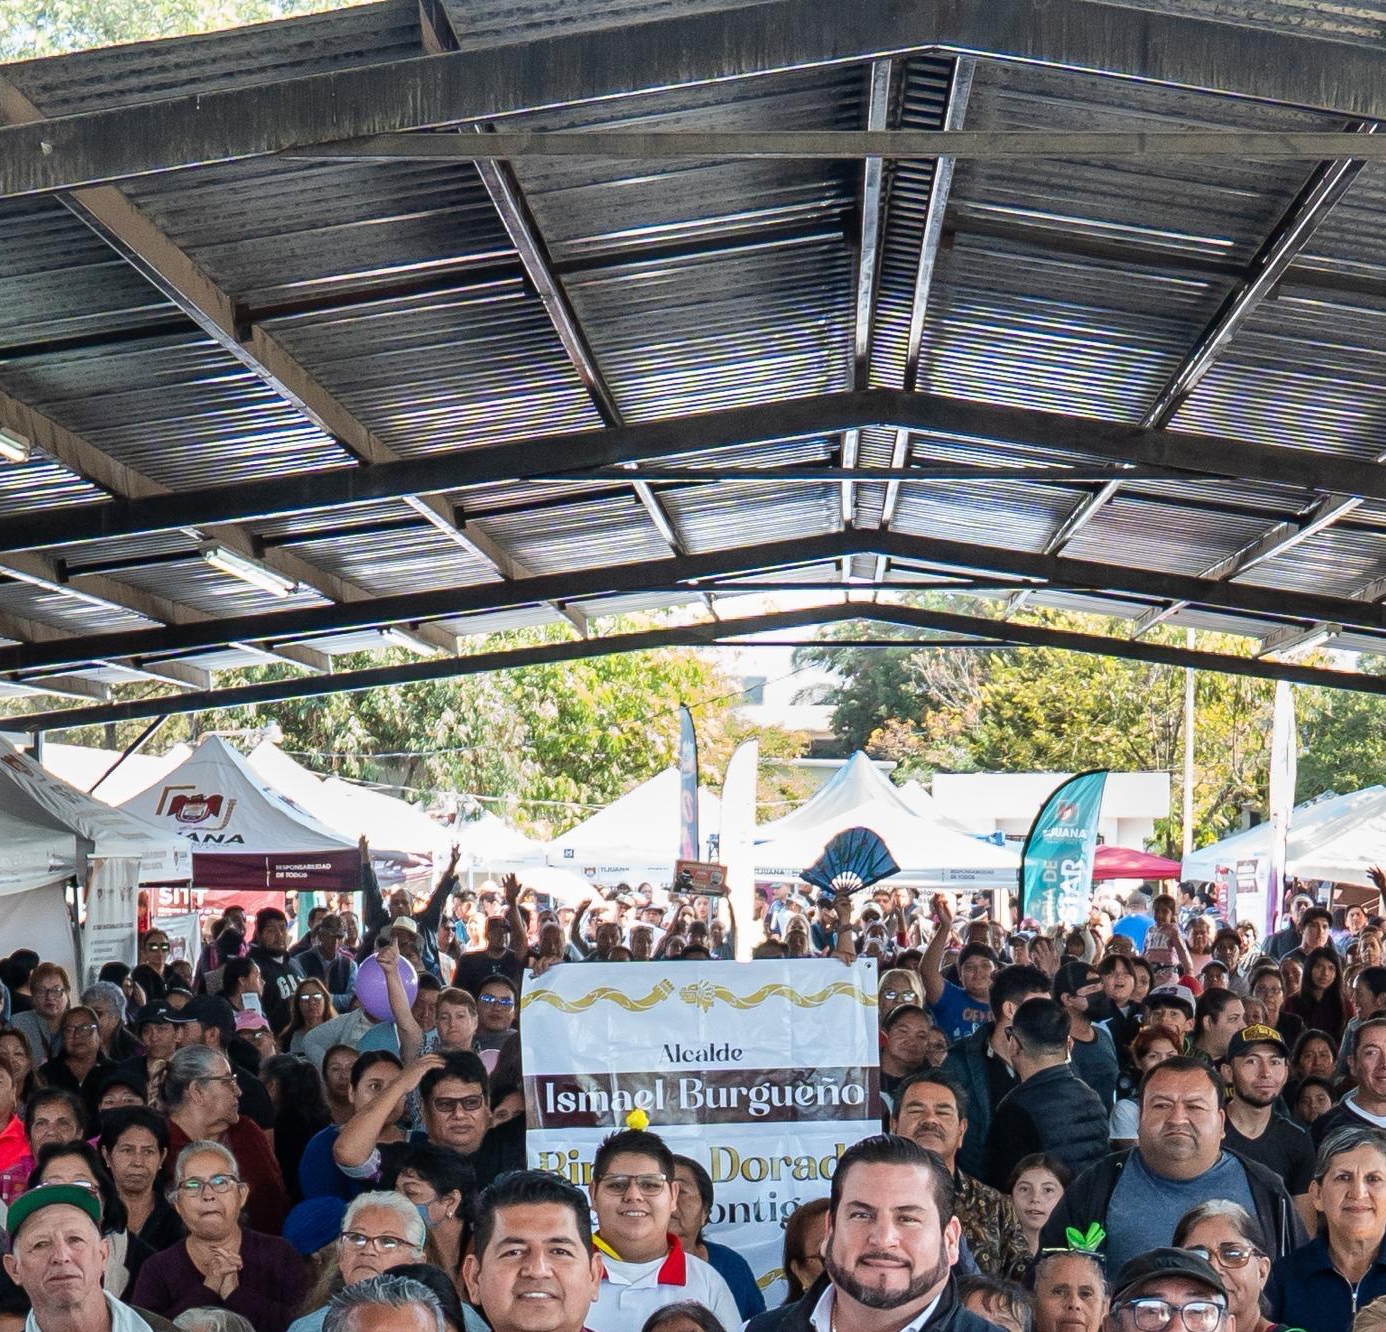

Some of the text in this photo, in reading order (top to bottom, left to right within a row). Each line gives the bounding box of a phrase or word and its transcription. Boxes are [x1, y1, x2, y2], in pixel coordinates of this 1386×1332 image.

[1043, 827, 1087, 839] JUANA
[660, 1043, 743, 1063] Alcalde
[545, 1076, 865, 1117] Ismael Burgueño
[702, 1191, 800, 1229] ontig
